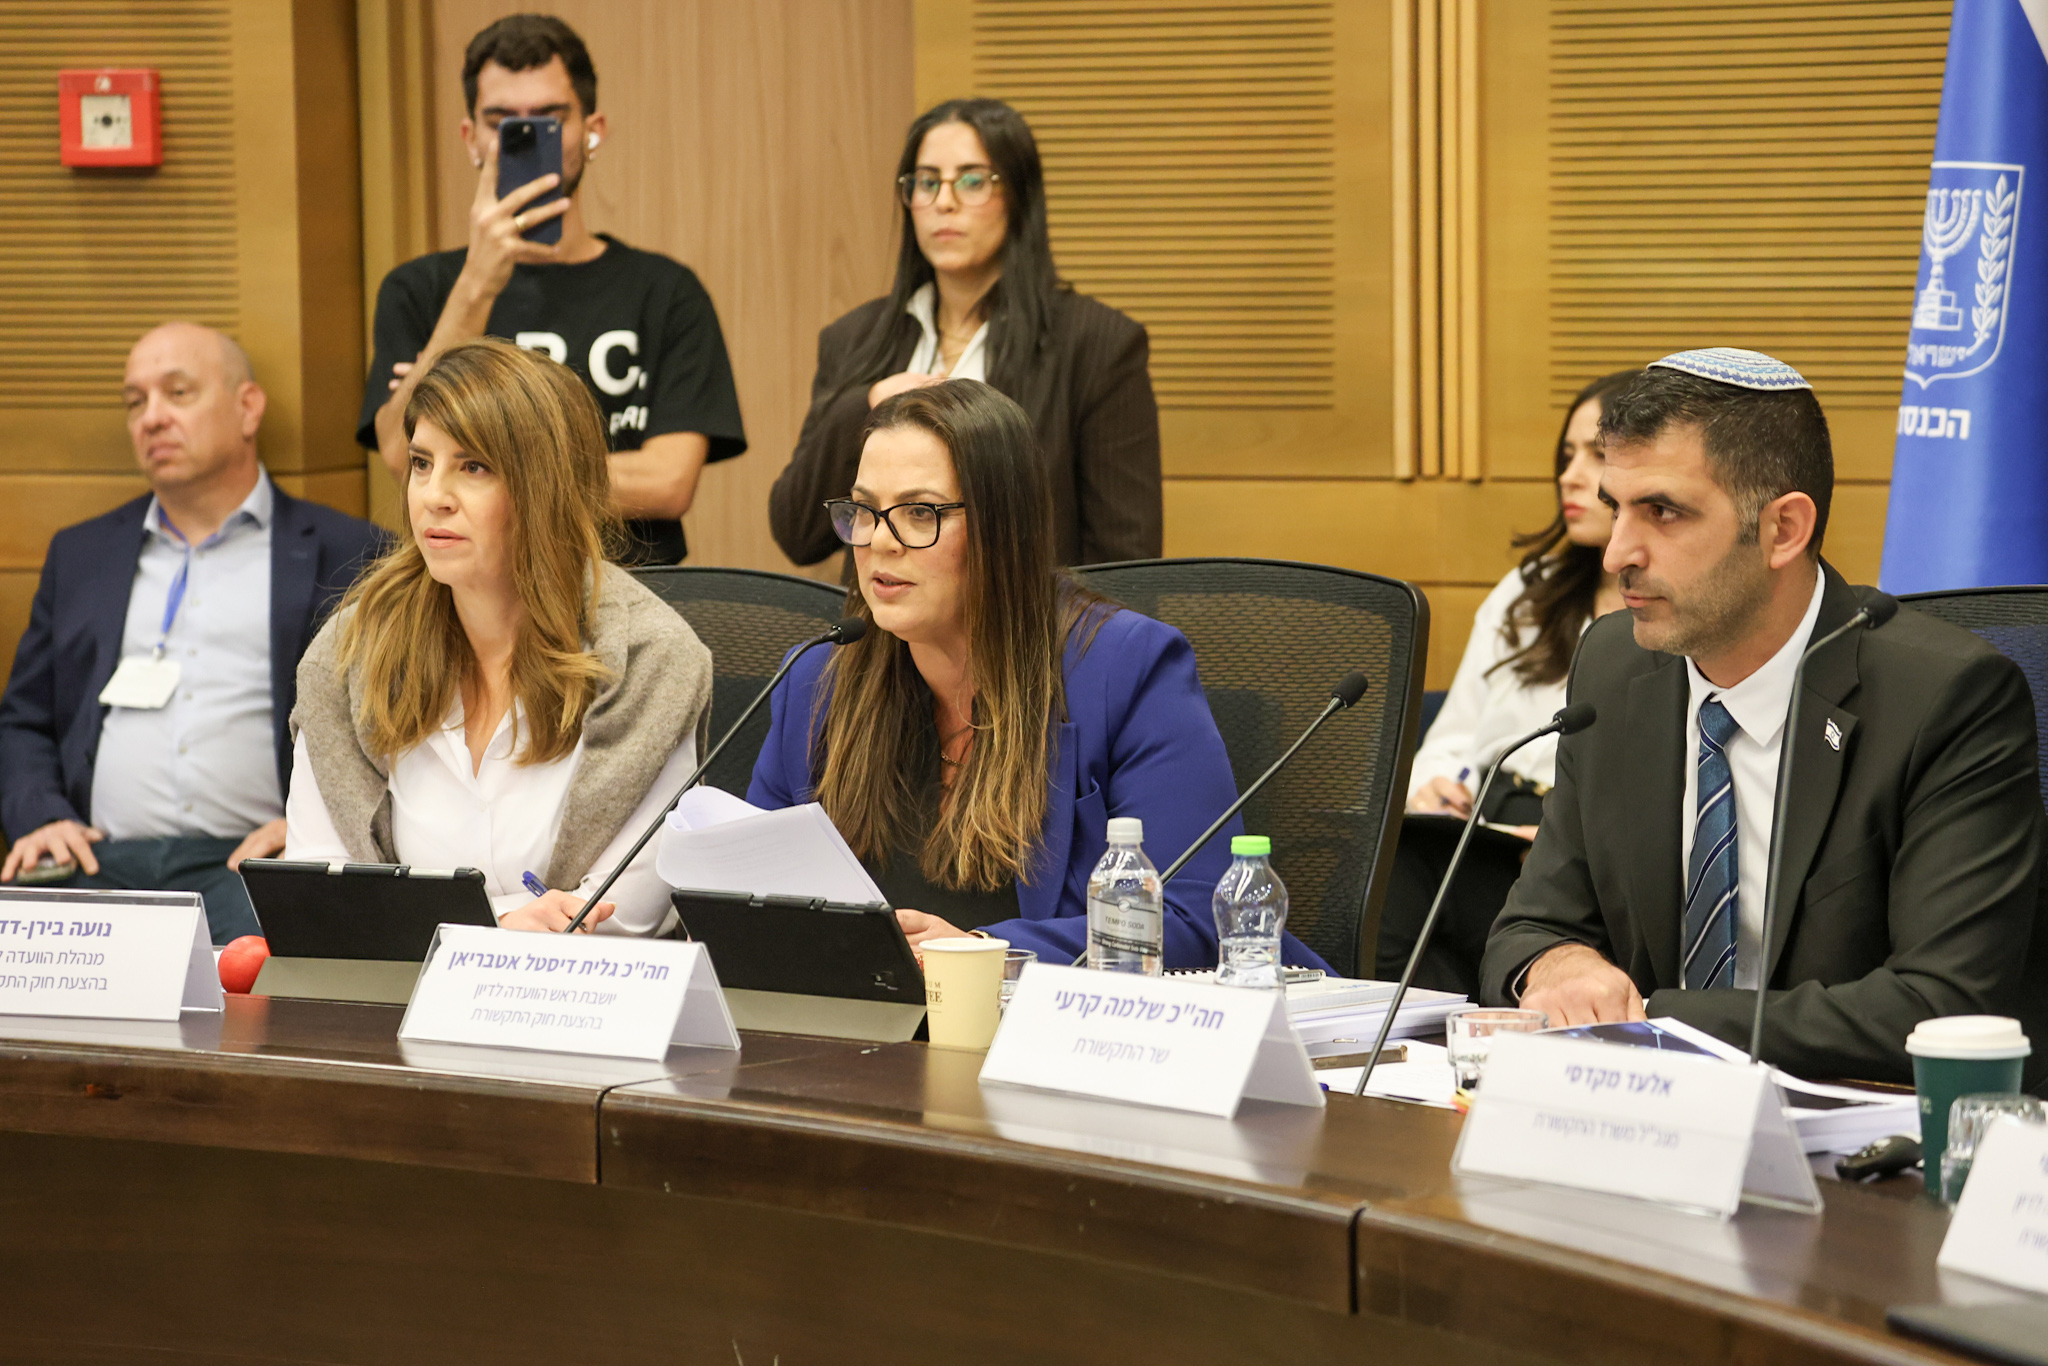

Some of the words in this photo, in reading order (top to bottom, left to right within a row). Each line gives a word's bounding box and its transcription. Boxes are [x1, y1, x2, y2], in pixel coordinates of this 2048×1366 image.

[1907, 343, 1967, 368] ישרא
[69, 921, 112, 937] נועה
[6, 950, 54, 965] הוועדה
[56, 949, 105, 966] מנהלת
[448, 950, 521, 971] אטבריאן
[525, 953, 577, 975] דיסטל
[578, 958, 618, 977] גלית
[29, 976, 55, 993] חוק
[57, 975, 108, 991] בהצעת
[473, 982, 503, 1000] לדיון
[503, 986, 548, 1001] הוועדה
[549, 988, 578, 1003] ראש
[578, 990, 617, 1006] יושבת
[1054, 990, 1103, 1019] קרעי
[1103, 996, 1166, 1021] שלמה
[470, 1007, 531, 1026] התקשורת
[530, 1011, 556, 1028] חוק
[557, 1014, 604, 1030] בהצעת
[1072, 1037, 1145, 1063] התקשורת
[1148, 1045, 1171, 1065] שר
